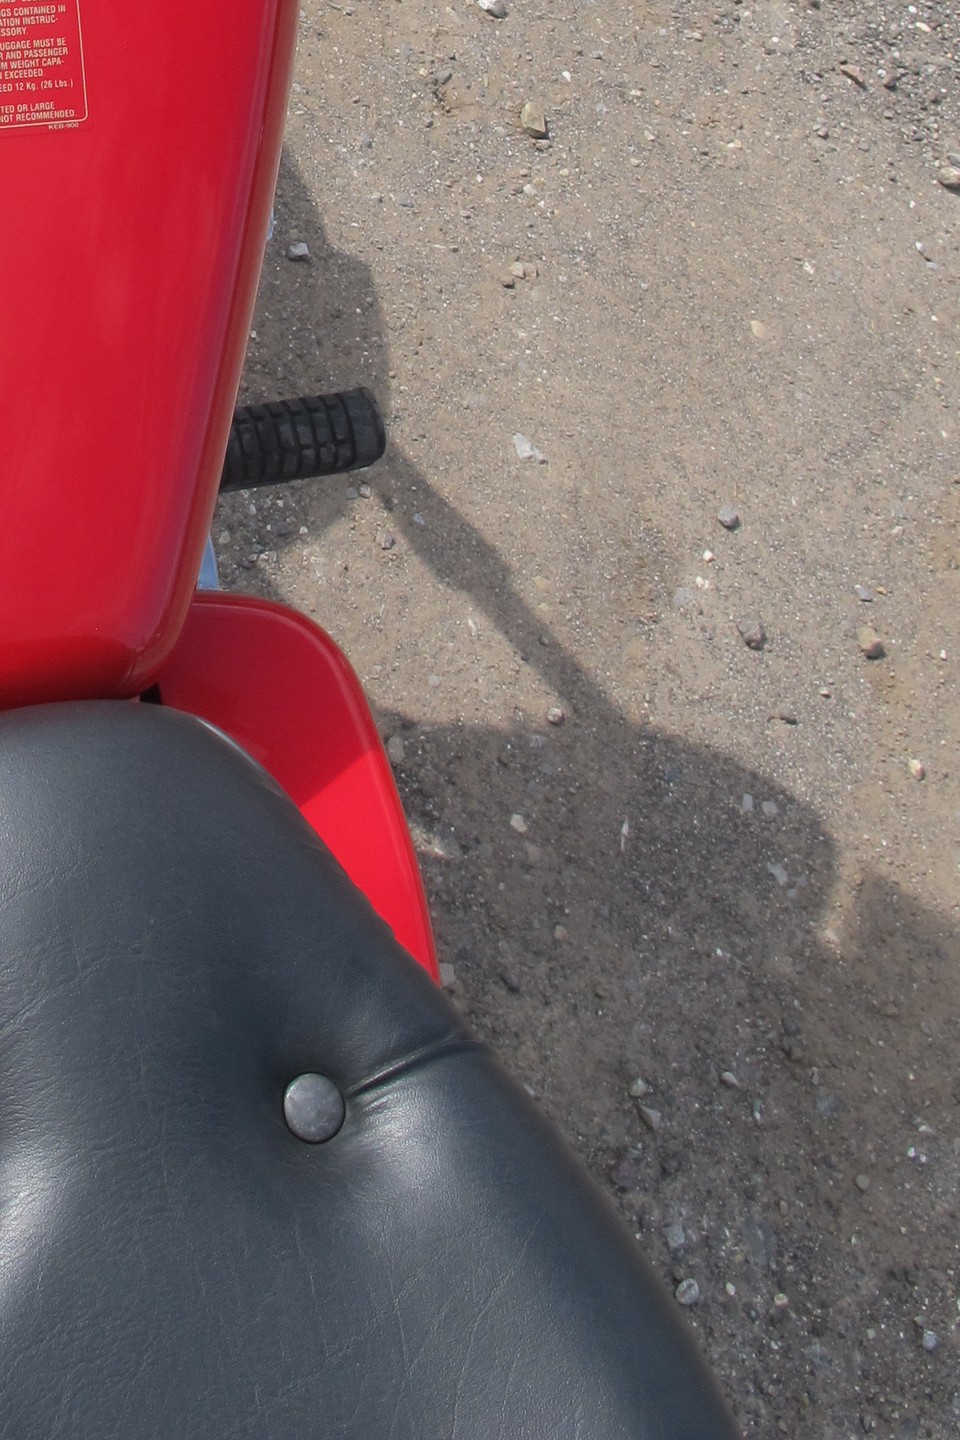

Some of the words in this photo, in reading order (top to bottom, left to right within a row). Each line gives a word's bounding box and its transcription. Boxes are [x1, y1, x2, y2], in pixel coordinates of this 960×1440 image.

[13, 4, 56, 16] CONTAINED
[57, 4, 66, 12] IN
[22, 14, 58, 25] INSTRUC-
[32, 38, 54, 47] MUST
[56, 37, 66, 46] BE
[5, 50, 21, 59] AND
[23, 46, 68, 58] PASSENGER
[10, 58, 39, 69] WEIGHT
[41, 56, 64, 66] CAPA-
[15, 82, 24, 91] 12
[16, 103, 28, 112] OR
[30, 101, 54, 111] LARGE
